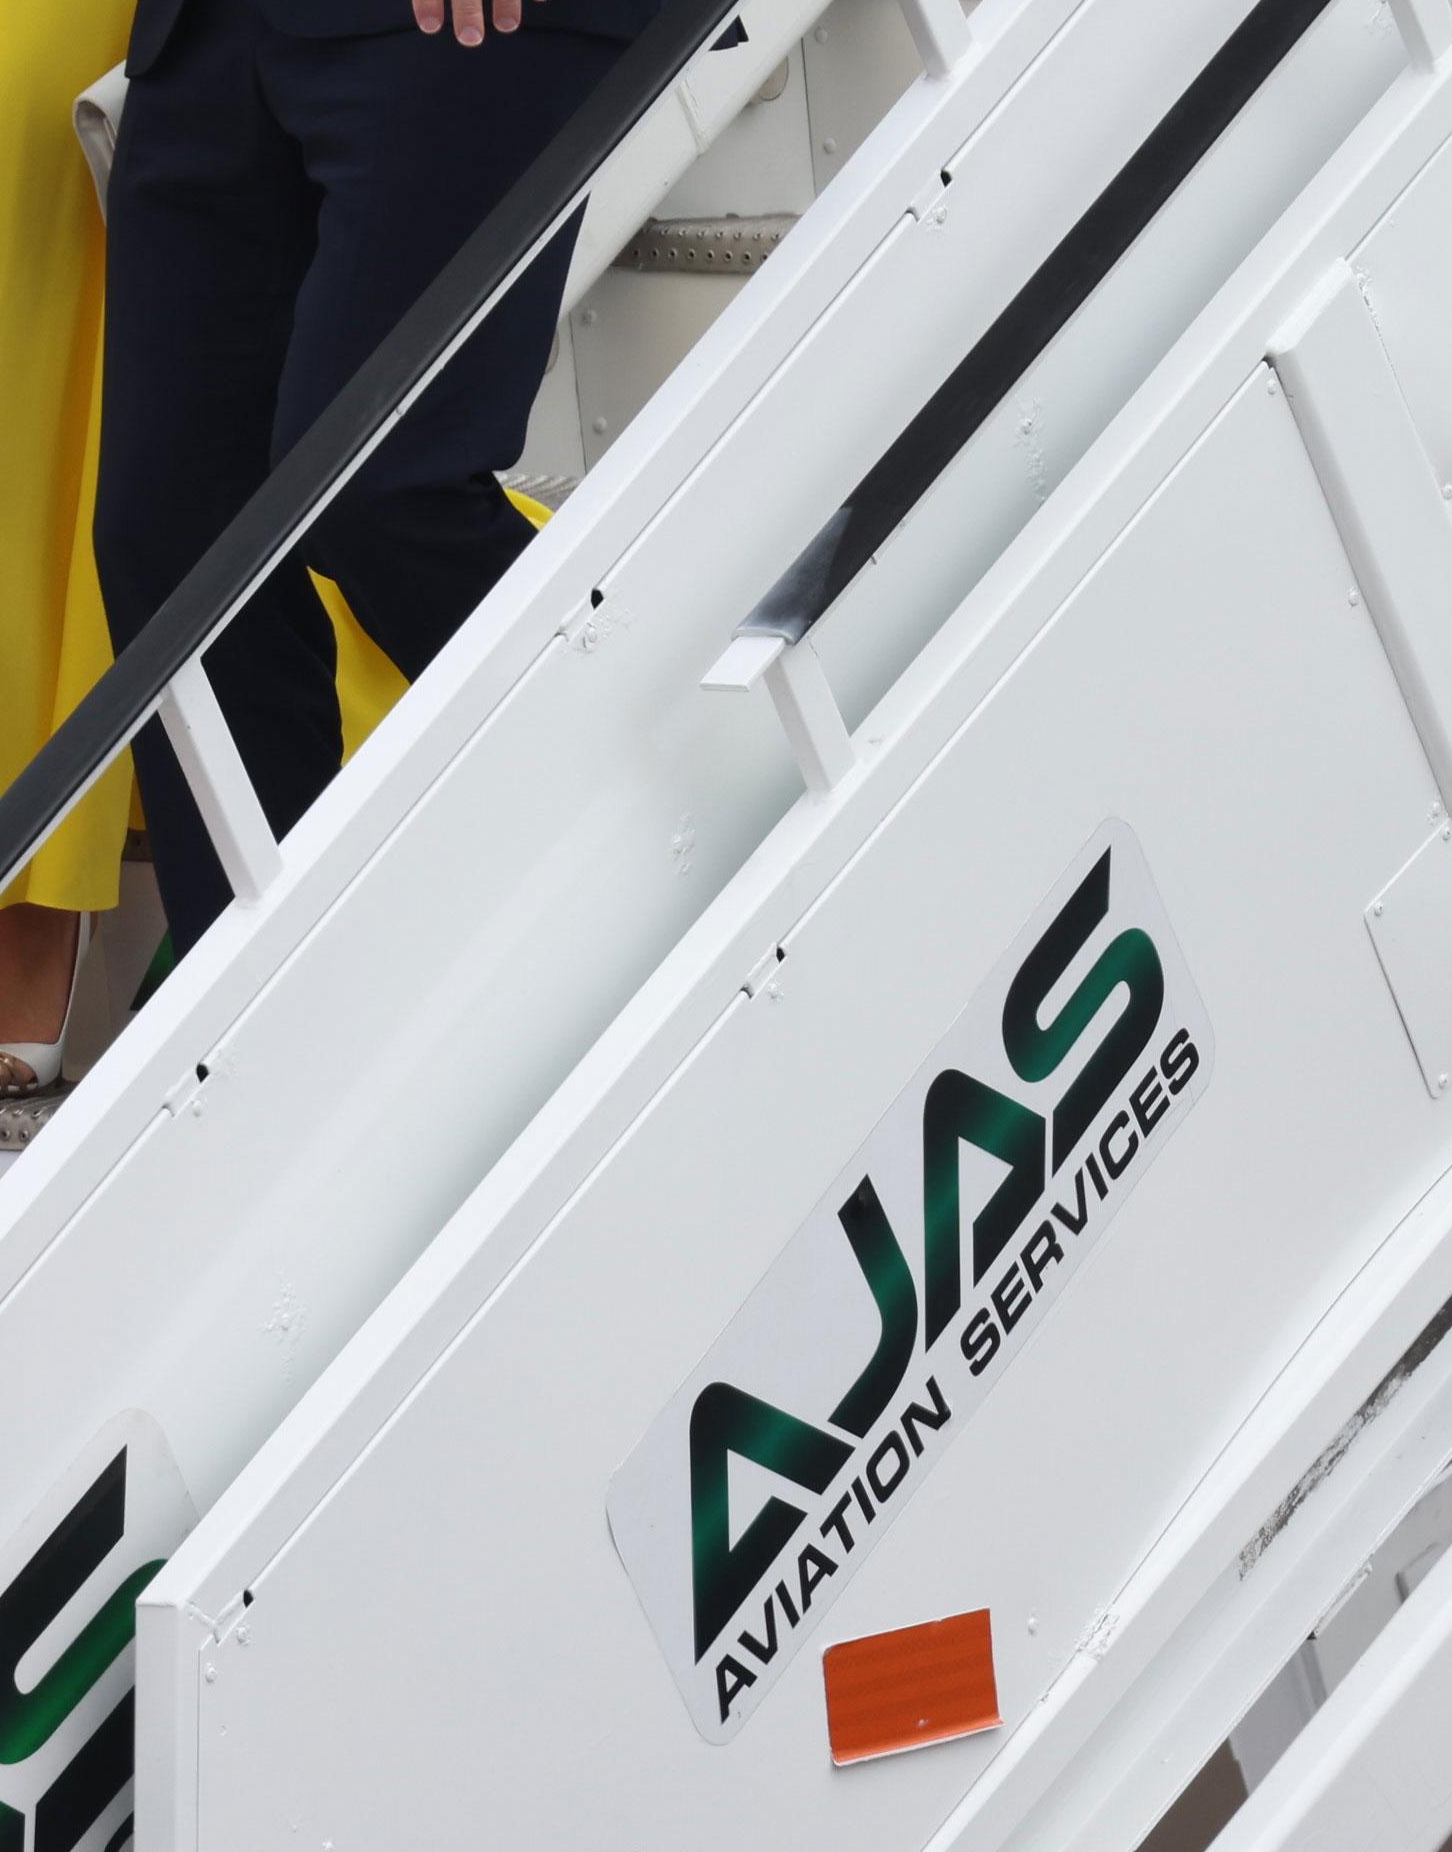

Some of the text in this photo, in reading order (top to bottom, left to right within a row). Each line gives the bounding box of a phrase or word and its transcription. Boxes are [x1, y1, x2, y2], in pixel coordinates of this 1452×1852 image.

[690, 846, 1164, 1665] AJAS
[716, 1028, 1199, 1724] AVIATION SERVICES
